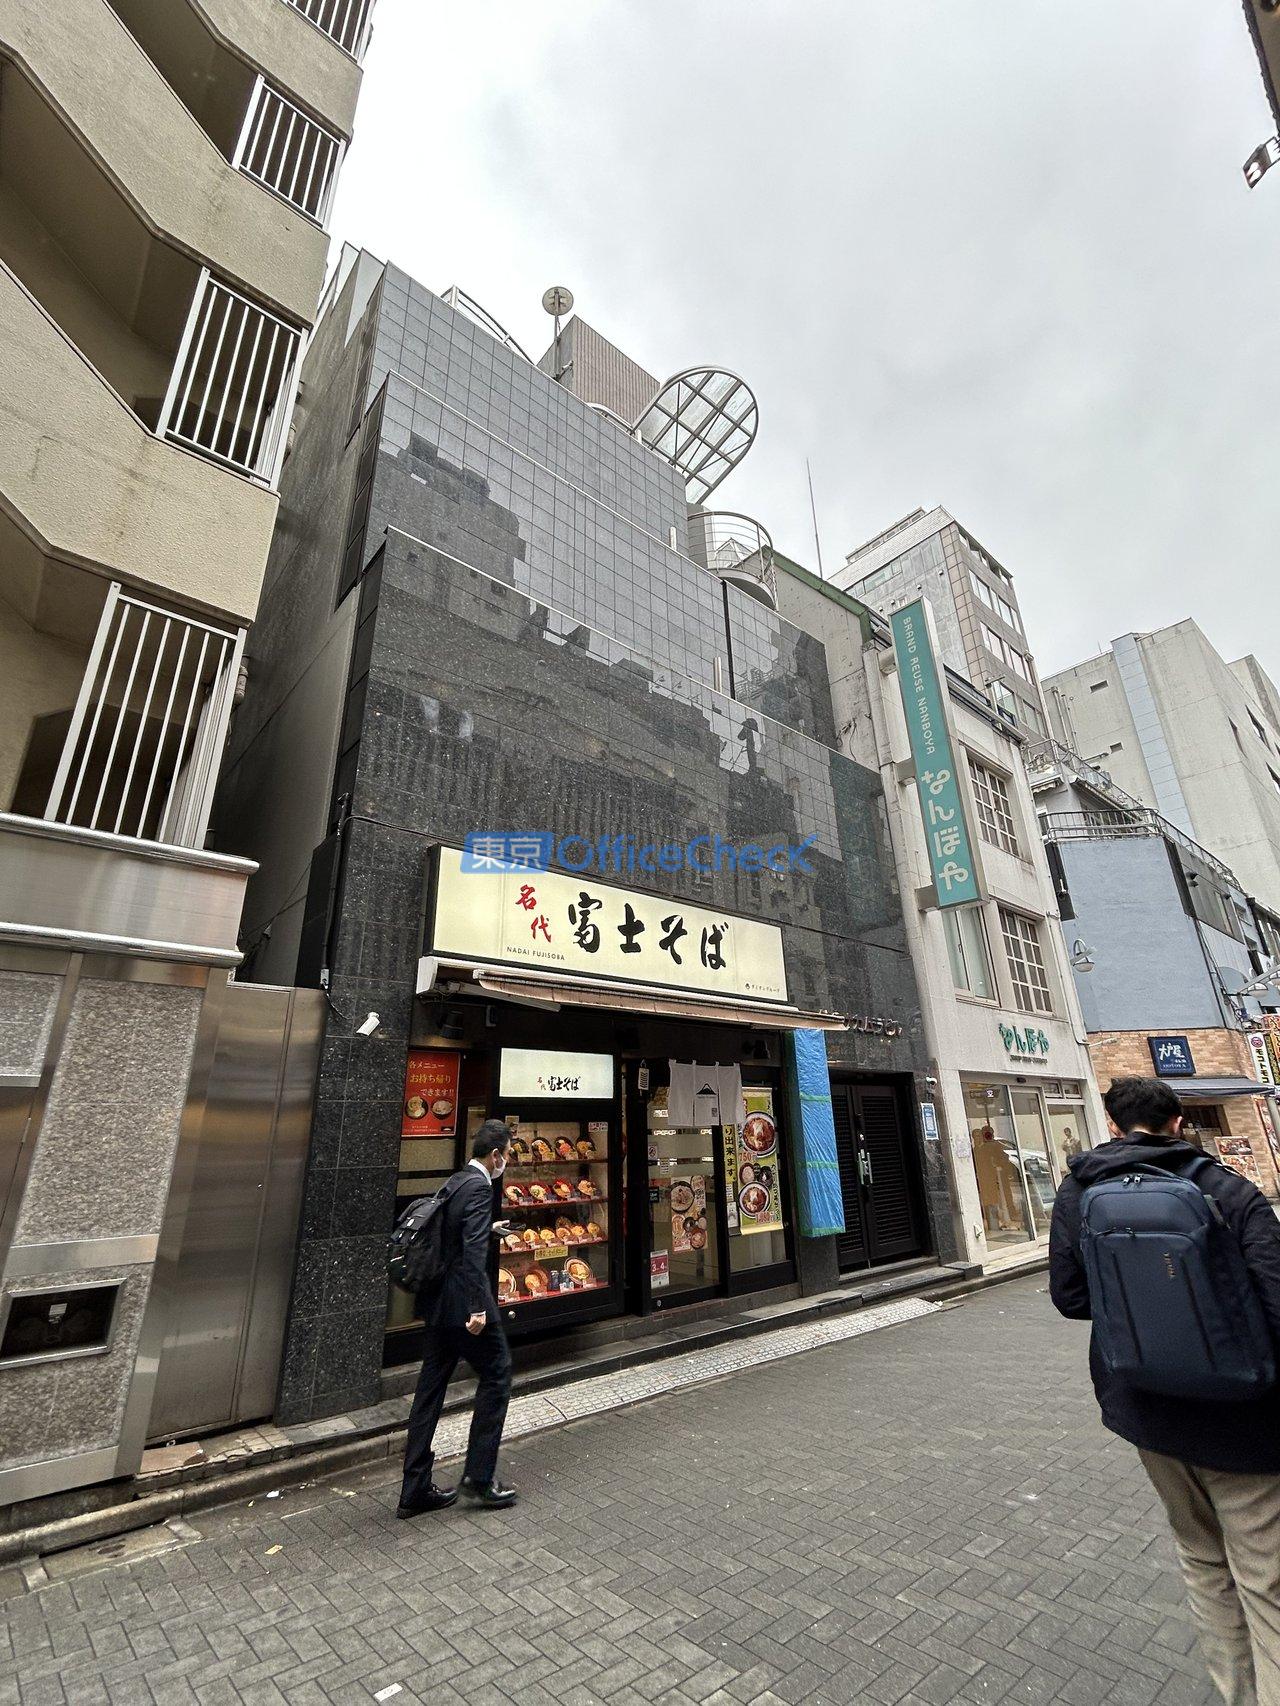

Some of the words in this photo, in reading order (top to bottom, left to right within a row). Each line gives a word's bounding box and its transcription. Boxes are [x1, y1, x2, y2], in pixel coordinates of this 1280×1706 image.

[903, 616, 917, 654] BRAND
[910, 657, 925, 693] REUSE
[917, 696, 936, 755] NANBOYA
[920, 768, 969, 891] なんぼや
[515, 884, 552, 943] 名代
[568, 891, 729, 970] 富士そば
[506, 946, 530, 955] NADAI
[532, 950, 565, 961] FUJISOBA
[998, 1022, 1050, 1055] なんぼや
